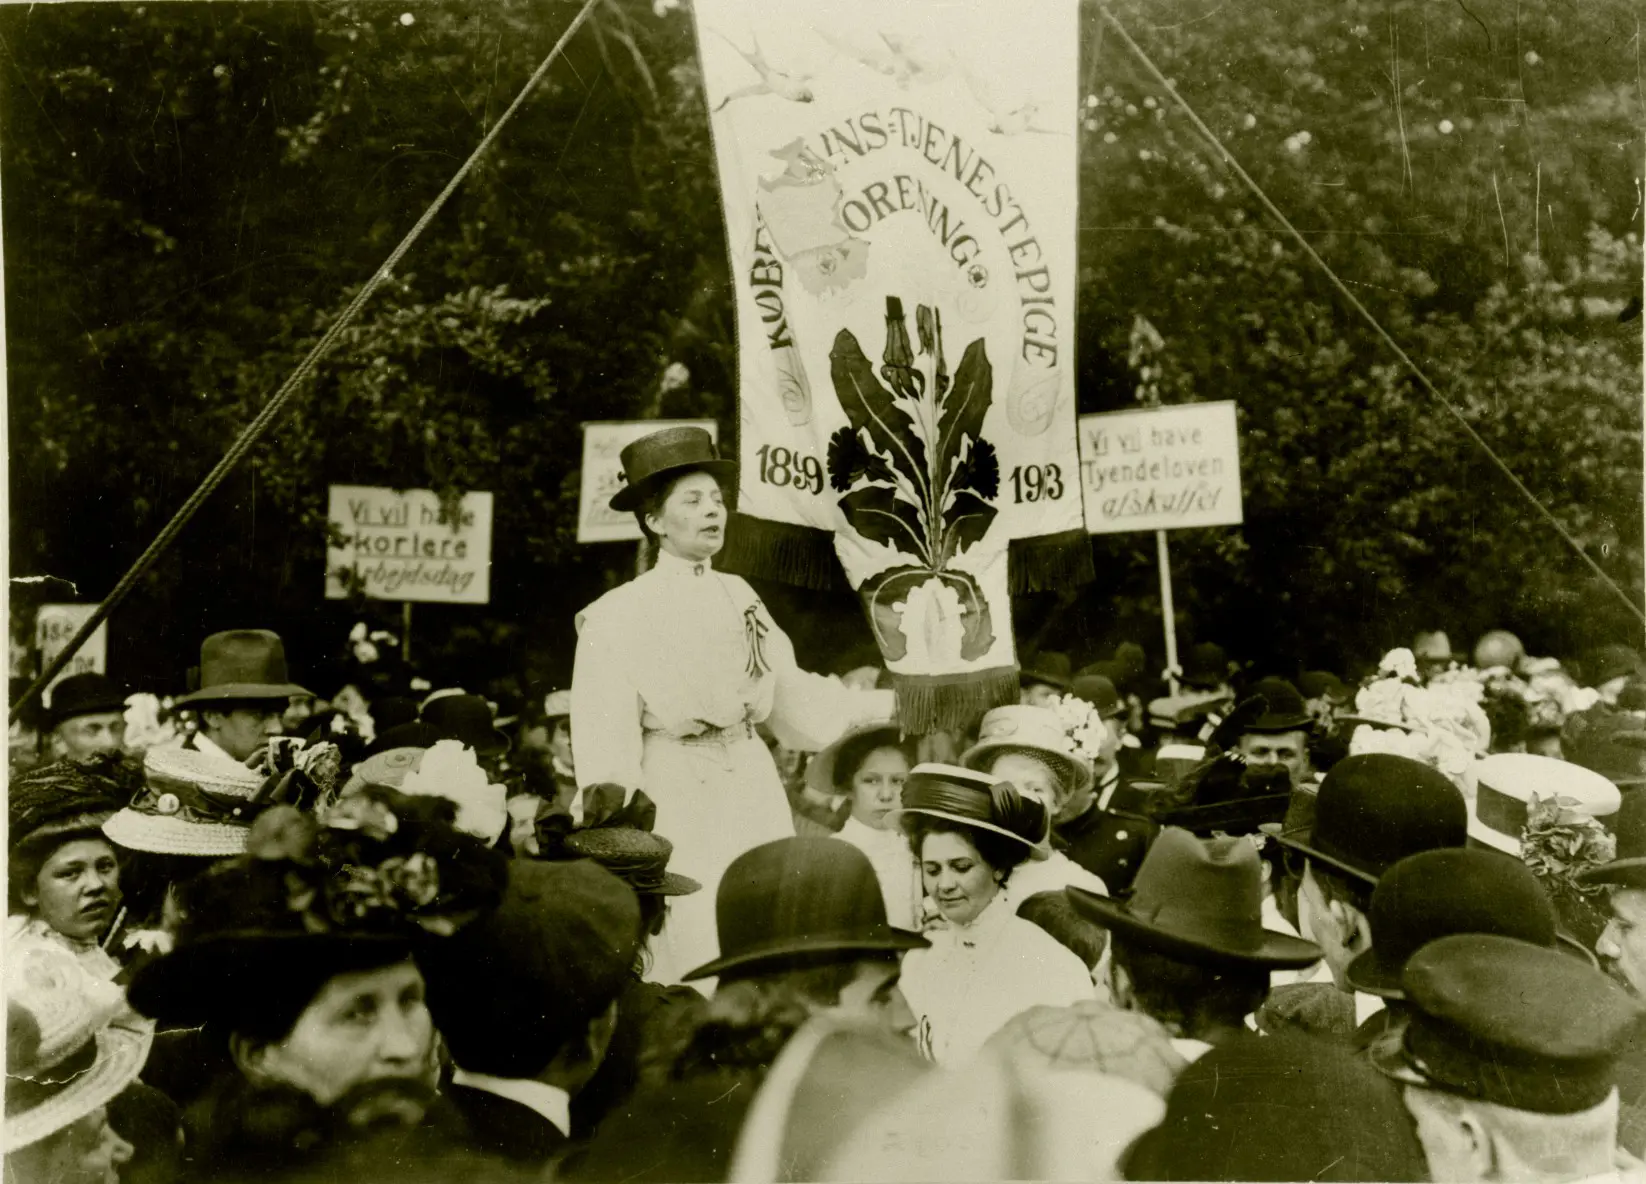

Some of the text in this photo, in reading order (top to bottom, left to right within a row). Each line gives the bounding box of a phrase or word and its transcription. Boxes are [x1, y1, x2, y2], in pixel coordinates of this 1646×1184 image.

[838, 174, 982, 268] ORENING
[1151, 427, 1202, 447] have
[1081, 455, 1225, 492] Tyendeloven
[420, 503, 475, 527] he
[356, 561, 475, 594] rbejdsdag
